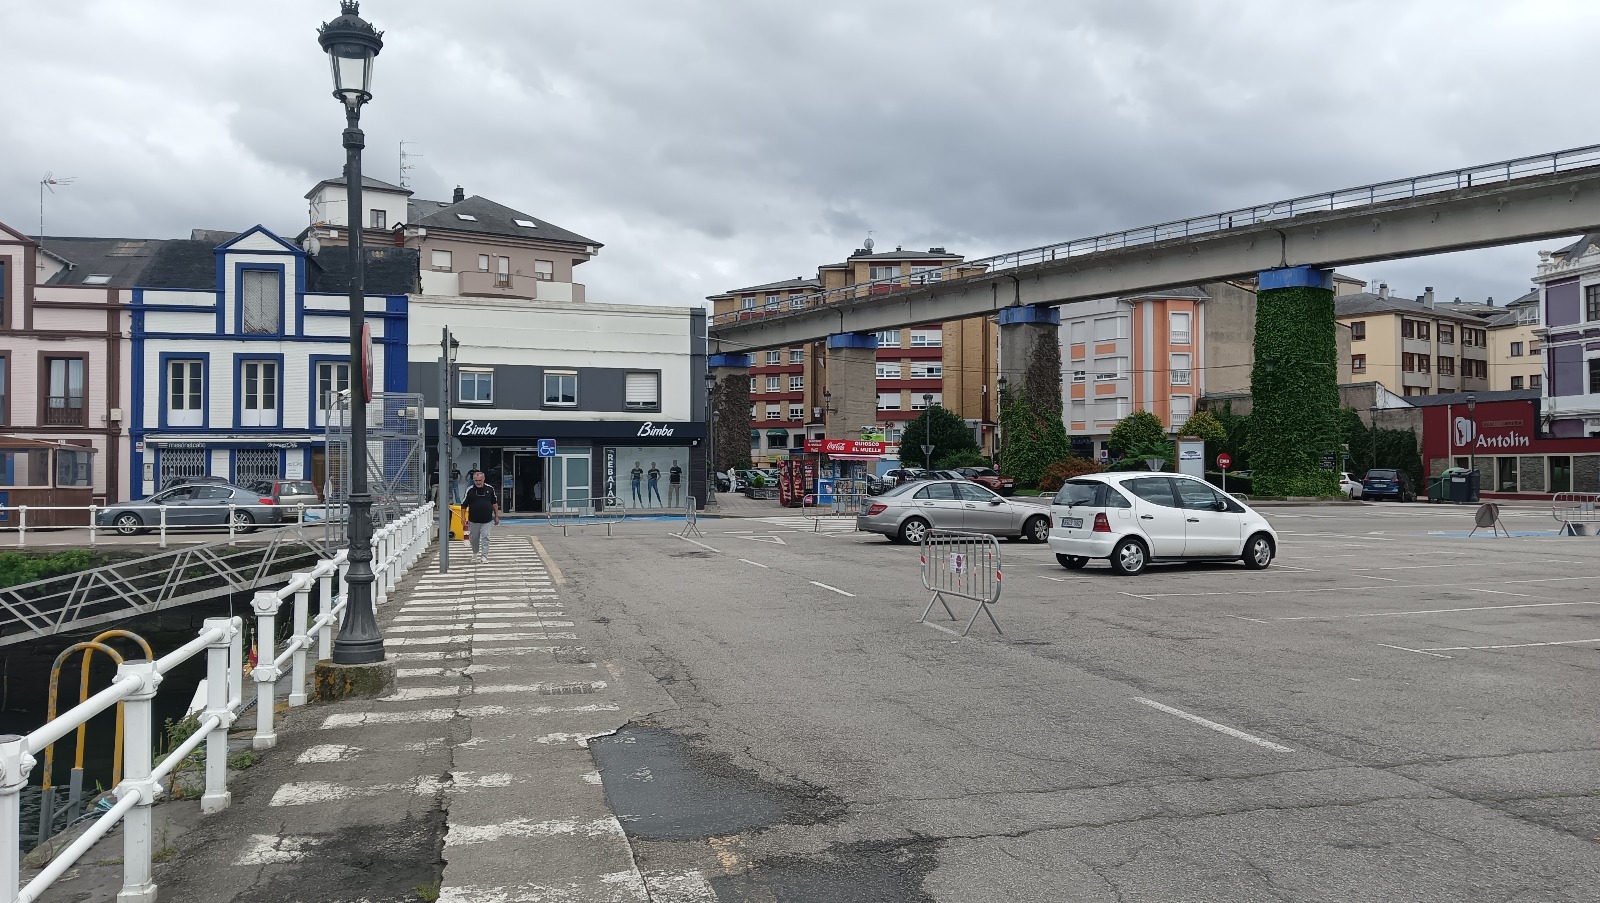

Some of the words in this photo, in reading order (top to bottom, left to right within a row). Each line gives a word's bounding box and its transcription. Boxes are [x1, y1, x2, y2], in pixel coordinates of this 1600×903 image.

[457, 420, 498, 436] Bimba
[636, 421, 675, 437] Bimba
[606, 453, 615, 504] REBAJAS
